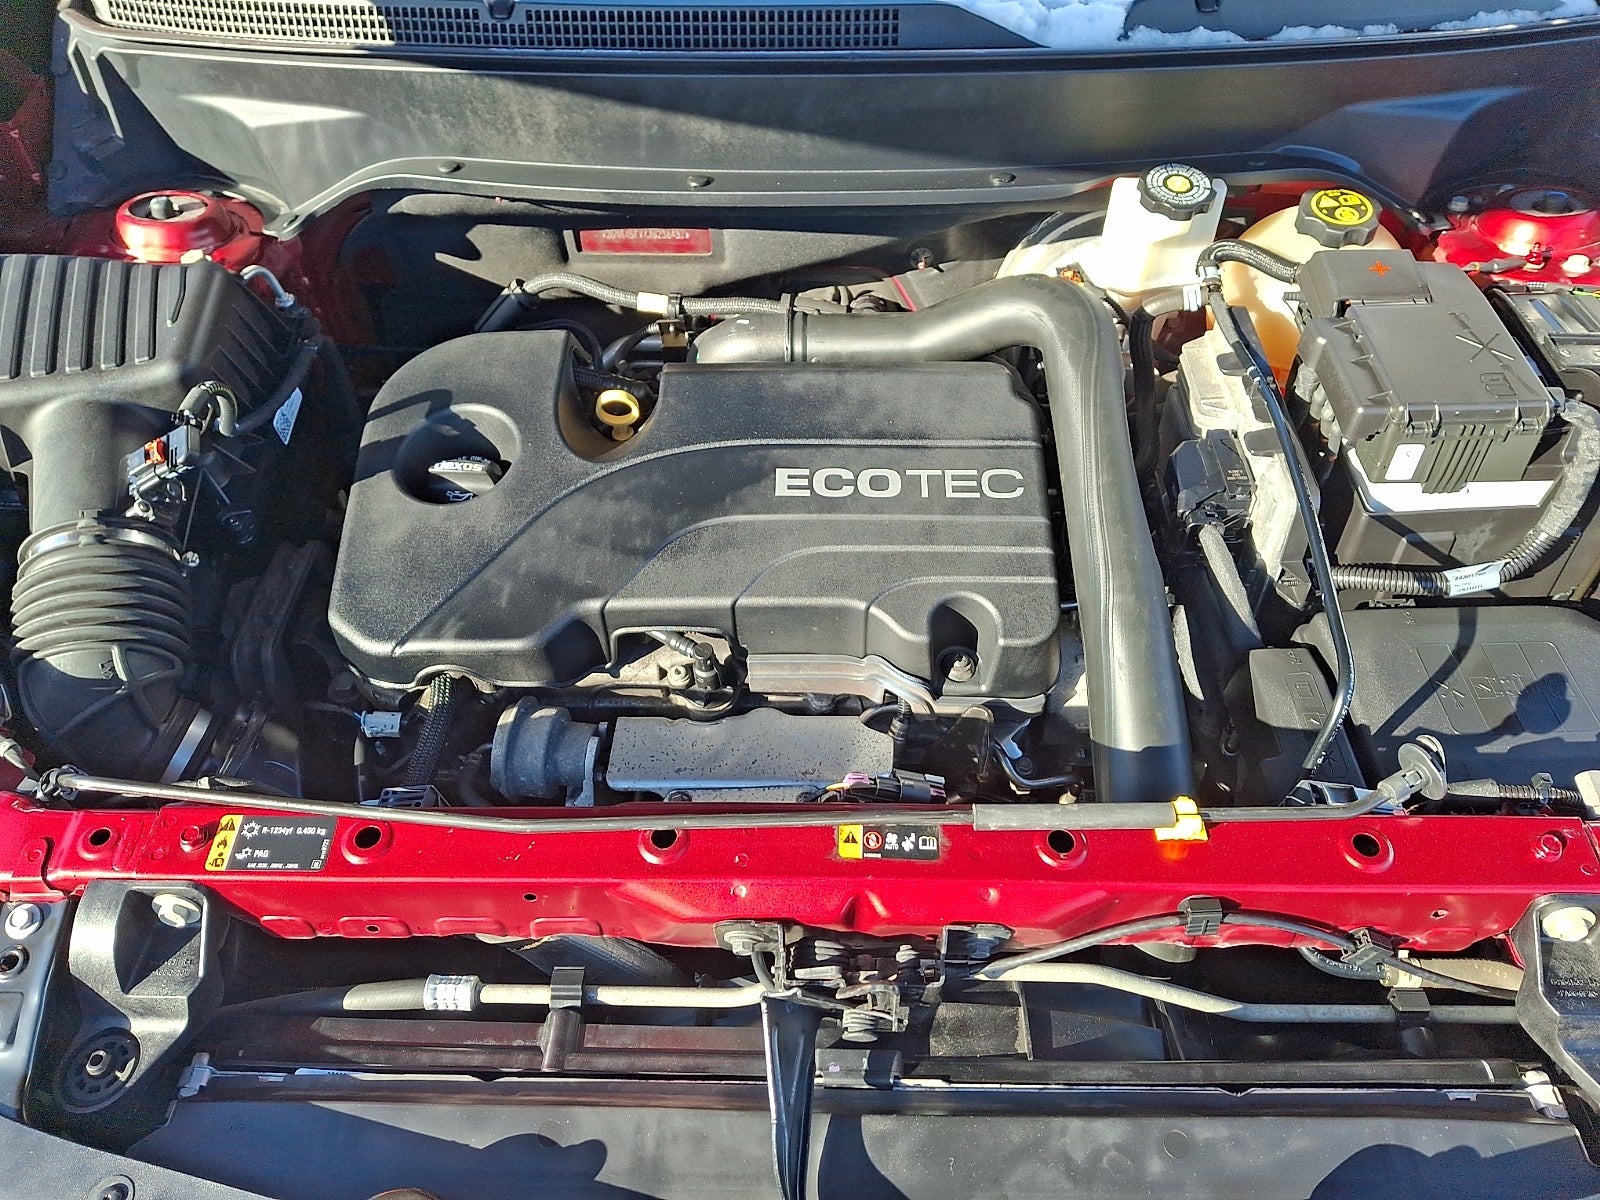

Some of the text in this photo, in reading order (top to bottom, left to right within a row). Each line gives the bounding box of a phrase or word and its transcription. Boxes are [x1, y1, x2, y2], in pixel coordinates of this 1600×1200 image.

[434, 461, 485, 471] dexos
[775, 467, 1025, 499] ECOTEC
[261, 826, 326, 836] R-1234yf 0.450 kg
[253, 850, 269, 858] PAG
